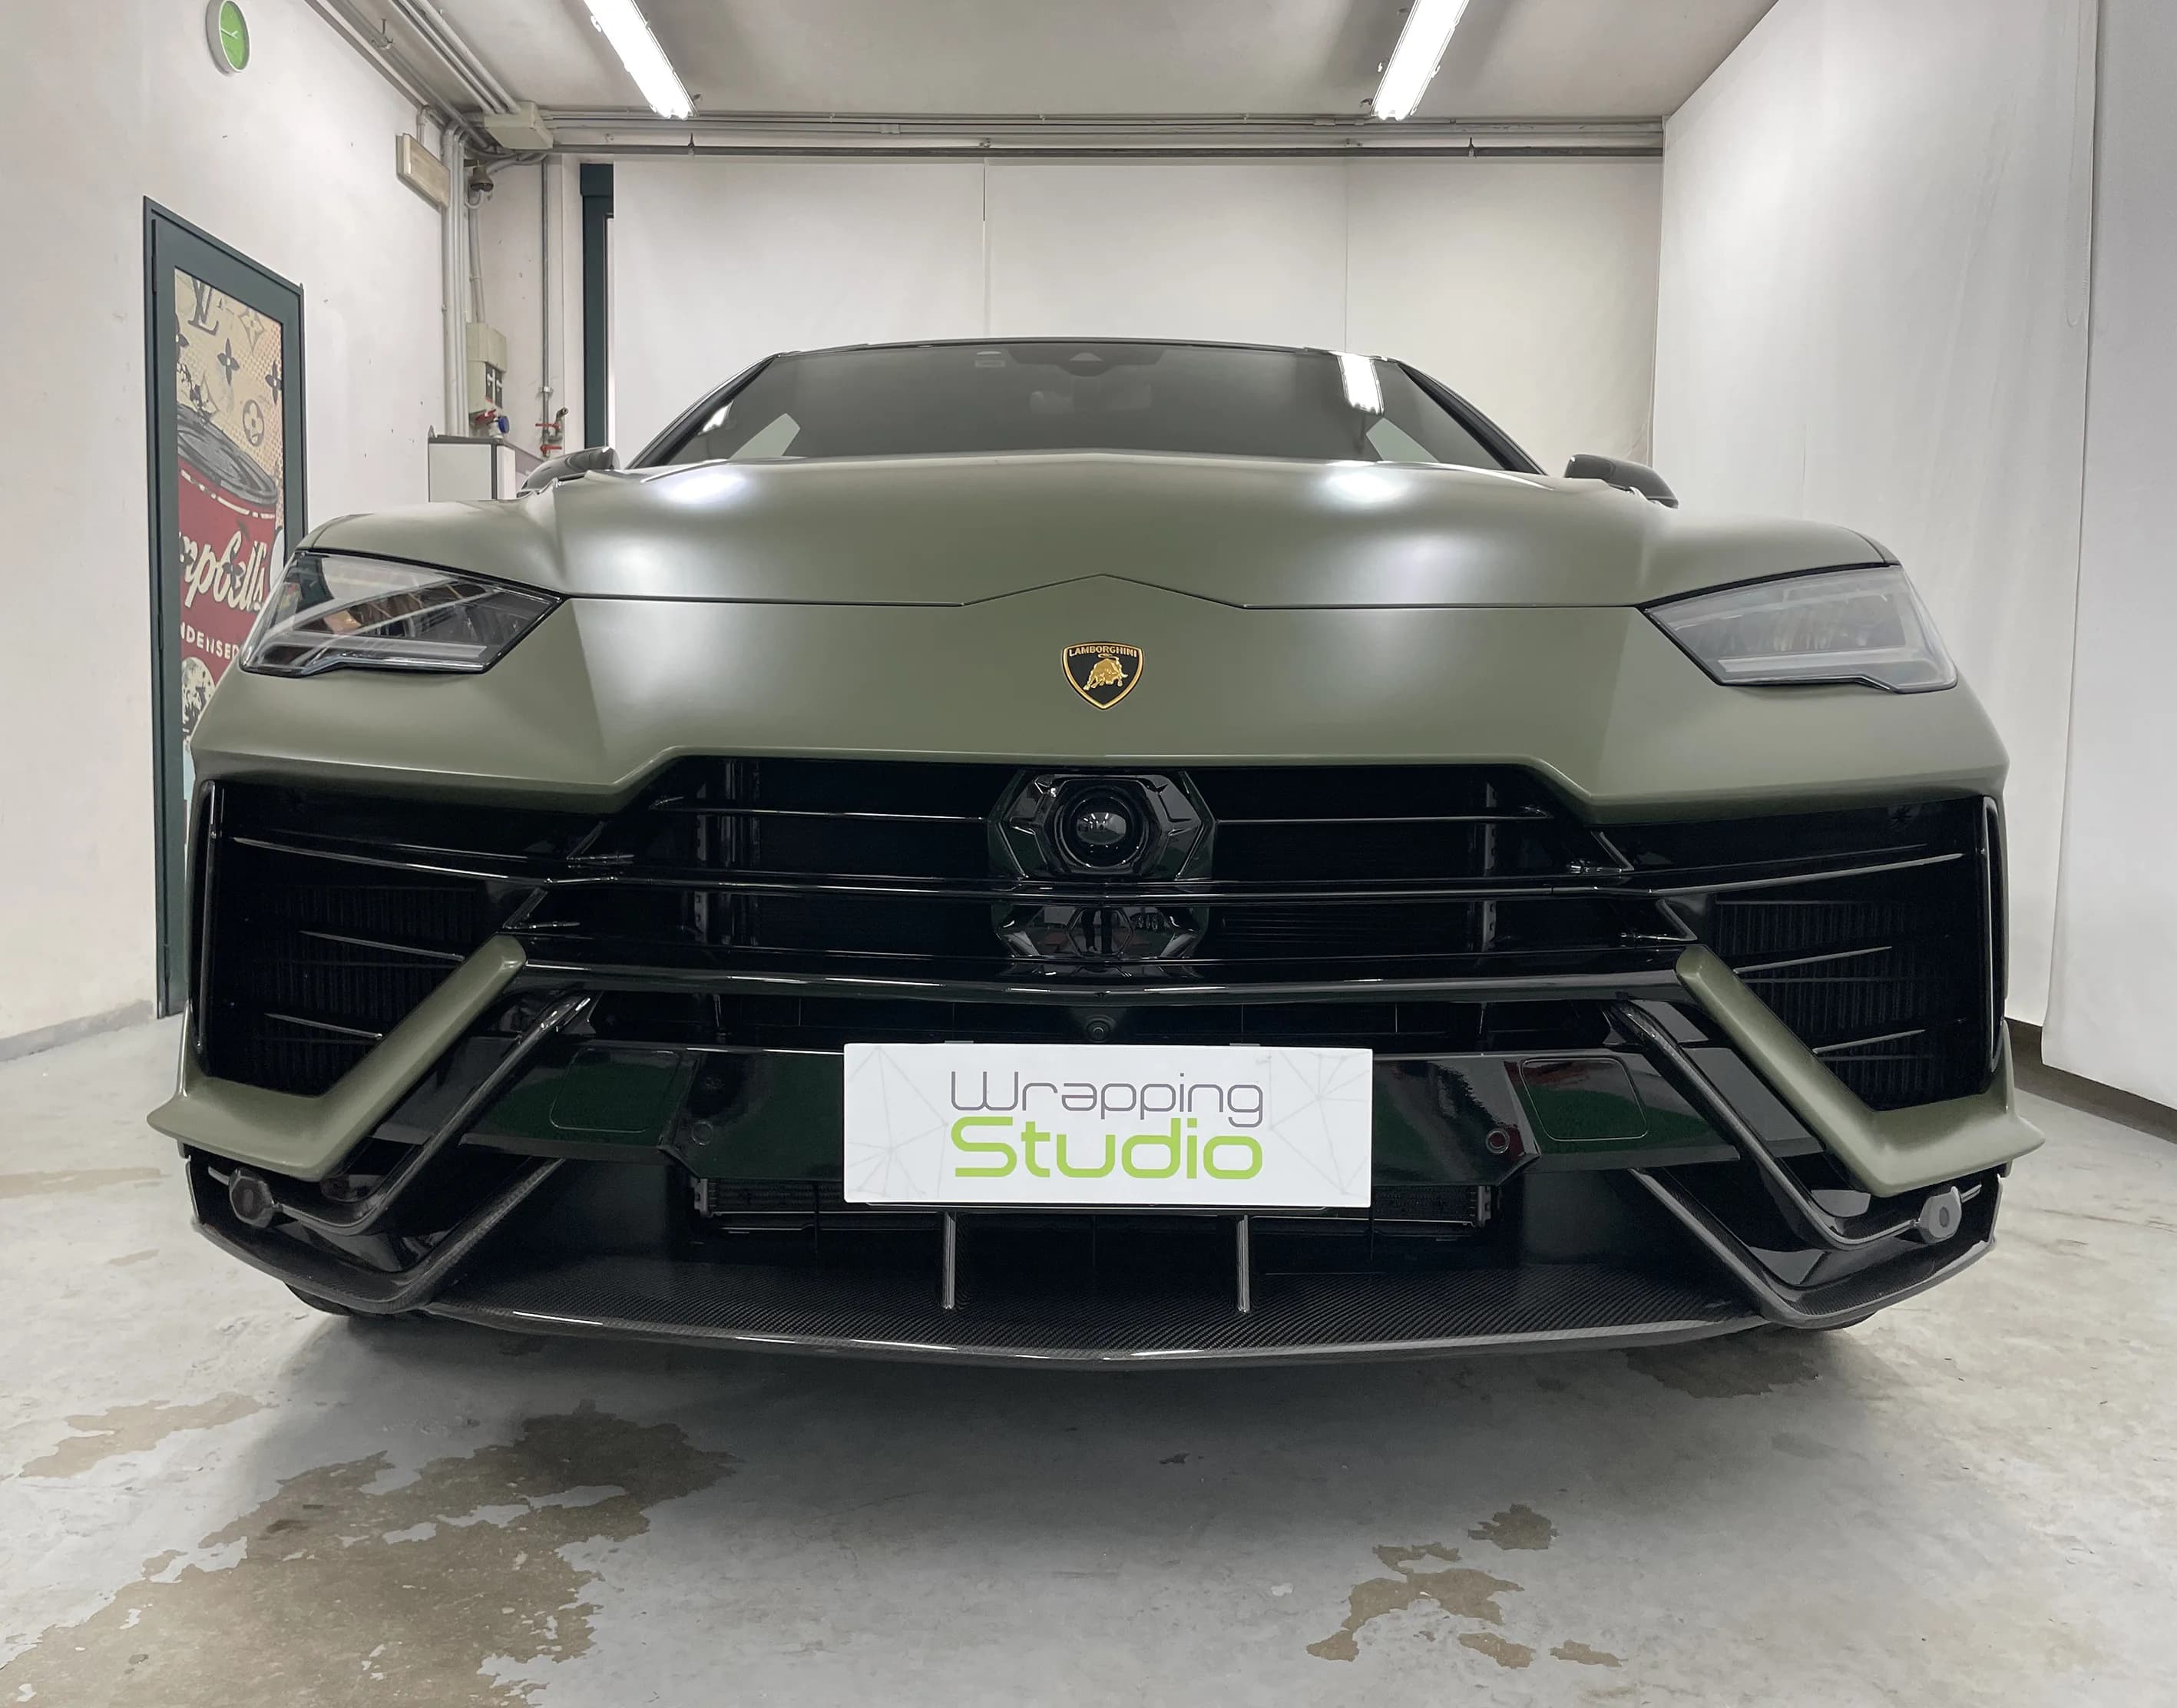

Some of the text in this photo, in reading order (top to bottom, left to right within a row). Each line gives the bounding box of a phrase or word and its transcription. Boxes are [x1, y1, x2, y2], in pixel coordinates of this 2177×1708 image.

[1069, 645, 1137, 657] LAMBORGHINI
[951, 1071, 1263, 1128] Wrapping
[951, 1116, 1262, 1180] Studio
